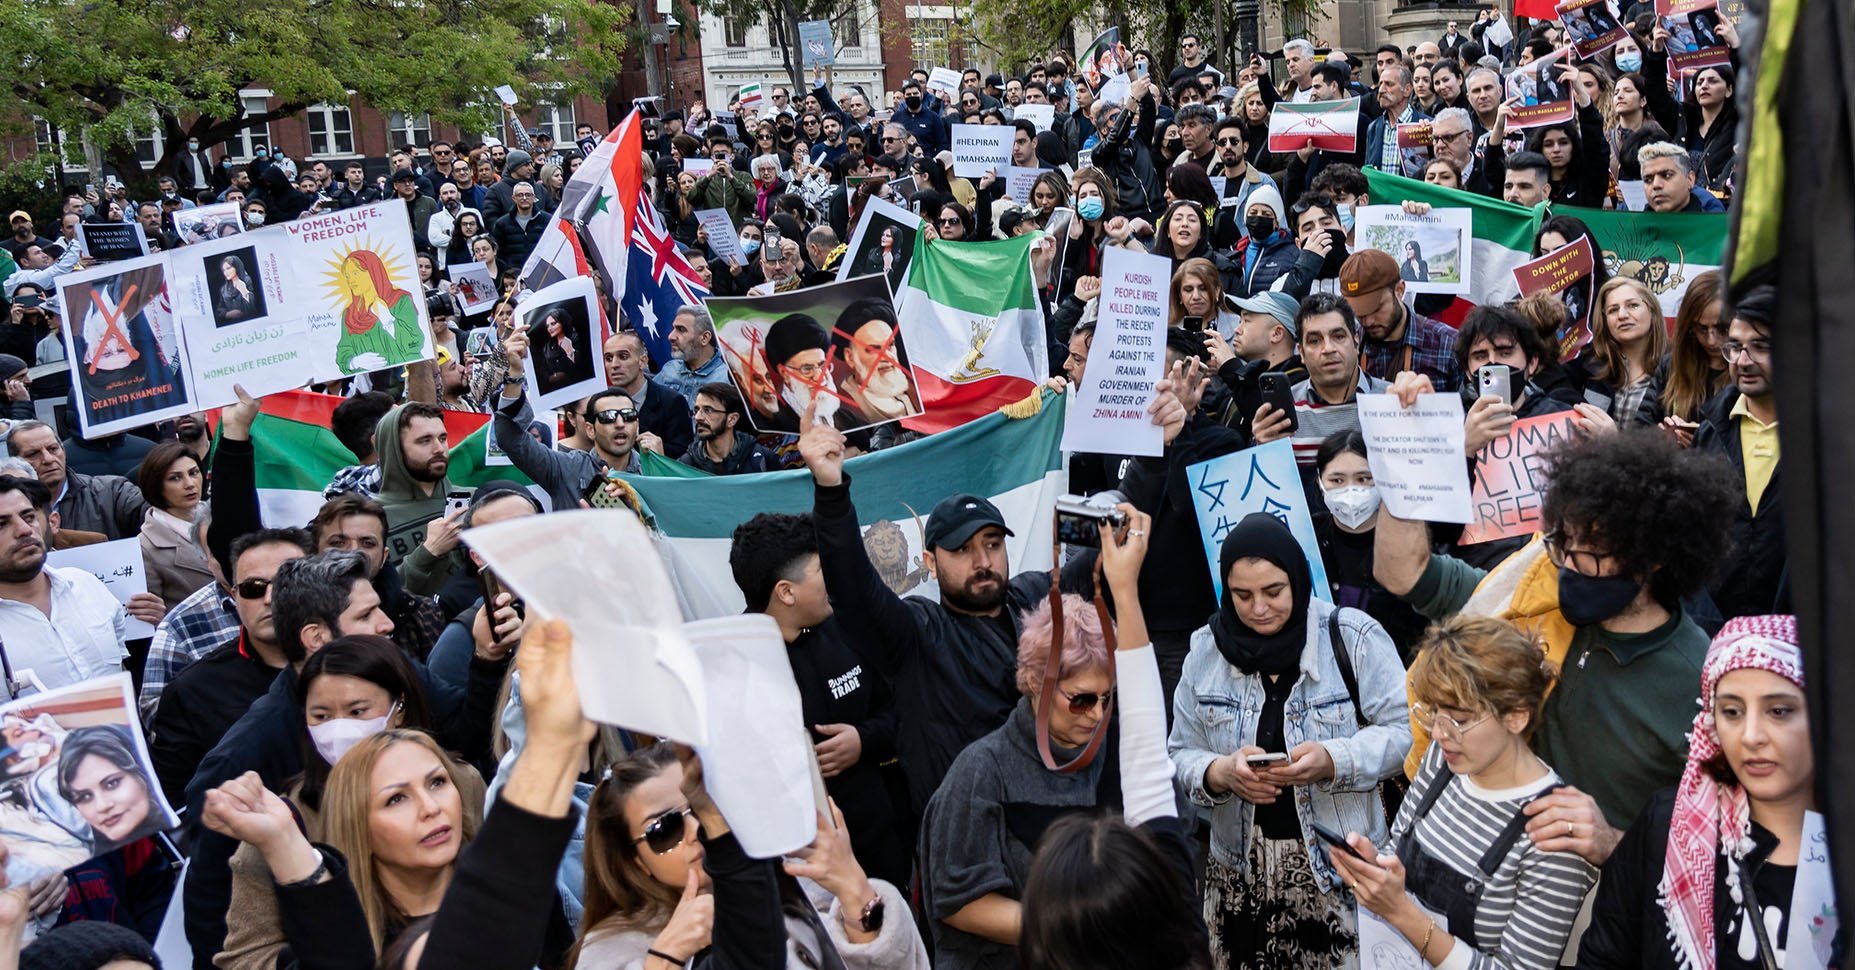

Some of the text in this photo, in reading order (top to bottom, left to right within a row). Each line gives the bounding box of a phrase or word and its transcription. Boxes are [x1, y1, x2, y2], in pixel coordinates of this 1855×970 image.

[956, 138, 999, 146] #HELPIRAN
[303, 222, 367, 243] FREEDOM
[1532, 248, 1579, 277] DOWN WITH
[1124, 272, 1152, 285] KURDISH
[1552, 266, 1567, 279] THE
[1546, 270, 1579, 293] ICTATOR
[1114, 288, 1158, 301] PEOPLE WERE
[1109, 303, 1160, 317] KILLED DURRING
[1116, 319, 1154, 331] THE RECENT
[1117, 335, 1151, 346] PROTESTS
[1109, 350, 1155, 362] AGAINST THE
[204, 351, 298, 380] WOMEN LIFE FREEDOM
[1115, 366, 1146, 376] IRANIAN
[1099, 380, 1154, 392] GOVERNMENT
[92, 394, 118, 410] DEATH
[118, 394, 129, 404] TO
[1098, 394, 1147, 405] MURDER OF
[1093, 408, 1143, 420] ZHINA AMINI
[831, 676, 860, 700] TRADE
